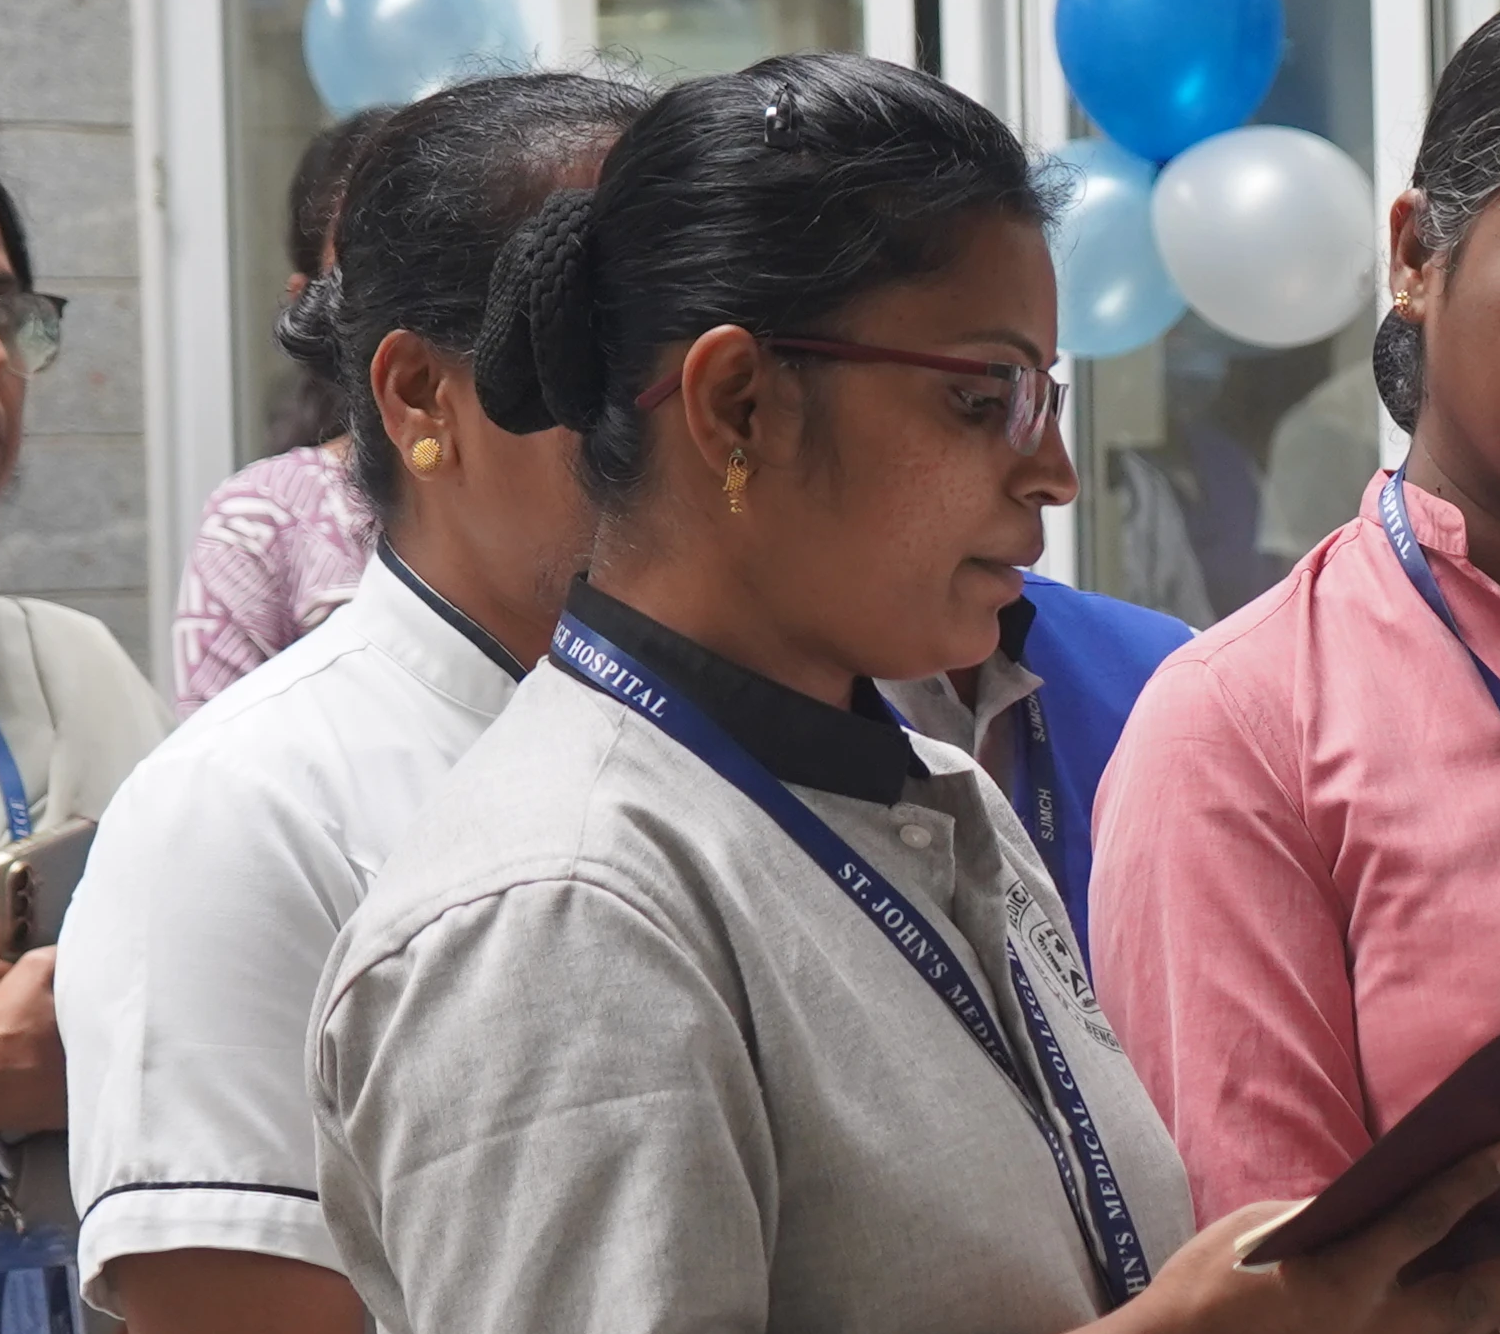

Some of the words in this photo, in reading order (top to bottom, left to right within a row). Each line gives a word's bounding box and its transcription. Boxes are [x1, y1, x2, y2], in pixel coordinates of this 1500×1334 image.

[567, 637, 667, 718] HOSPITAL
[1037, 788, 1055, 842] SJMCH
[838, 863, 872, 900] ST.
[871, 897, 949, 979] JOHN'S
[1016, 971, 1075, 1091] COLLEGE
[1072, 1101, 1127, 1221] MEDICAL
[1114, 1232, 1149, 1297] HN'S
